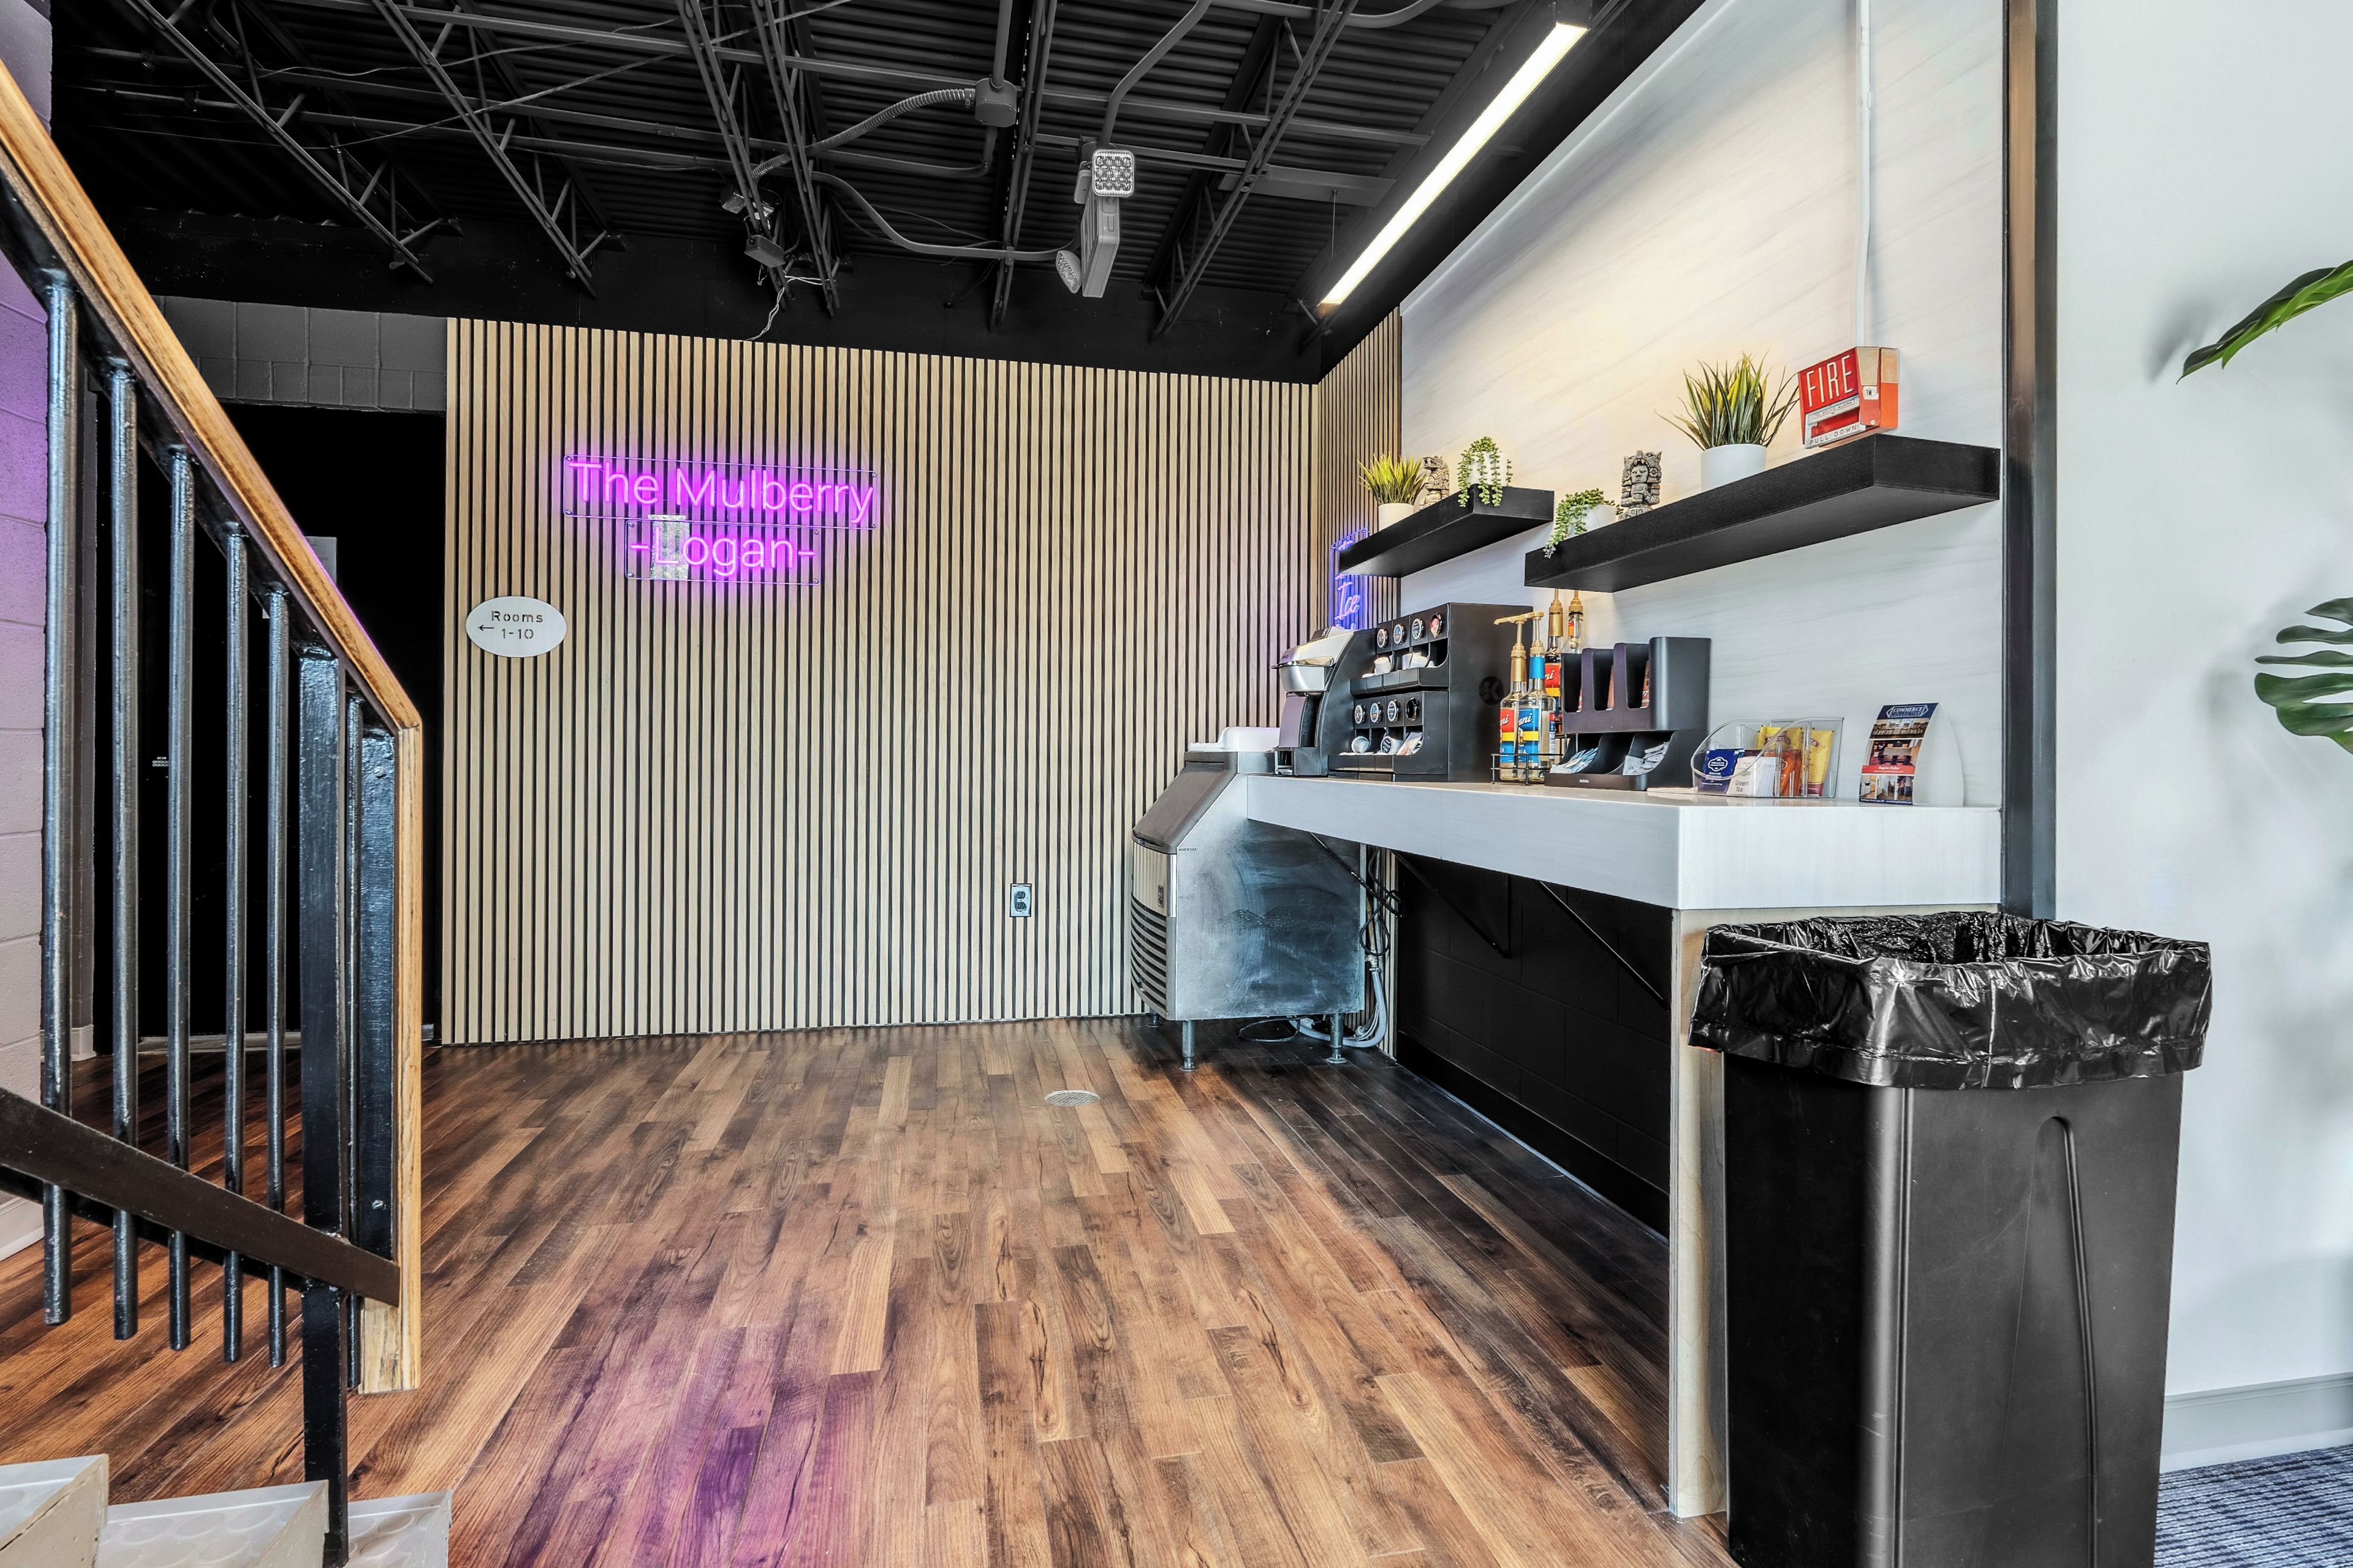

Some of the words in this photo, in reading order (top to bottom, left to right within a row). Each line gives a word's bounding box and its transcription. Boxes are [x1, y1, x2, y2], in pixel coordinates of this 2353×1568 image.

[1806, 355, 1854, 407] FIRE
[1809, 436, 1829, 445] PULL
[1833, 426, 1857, 437] DOWN
[569, 461, 659, 504] The
[676, 468, 874, 523] Mulberry
[630, 526, 816, 577] -Logan-
[491, 611, 543, 623] Rooms
[501, 628, 534, 639] 1-10
